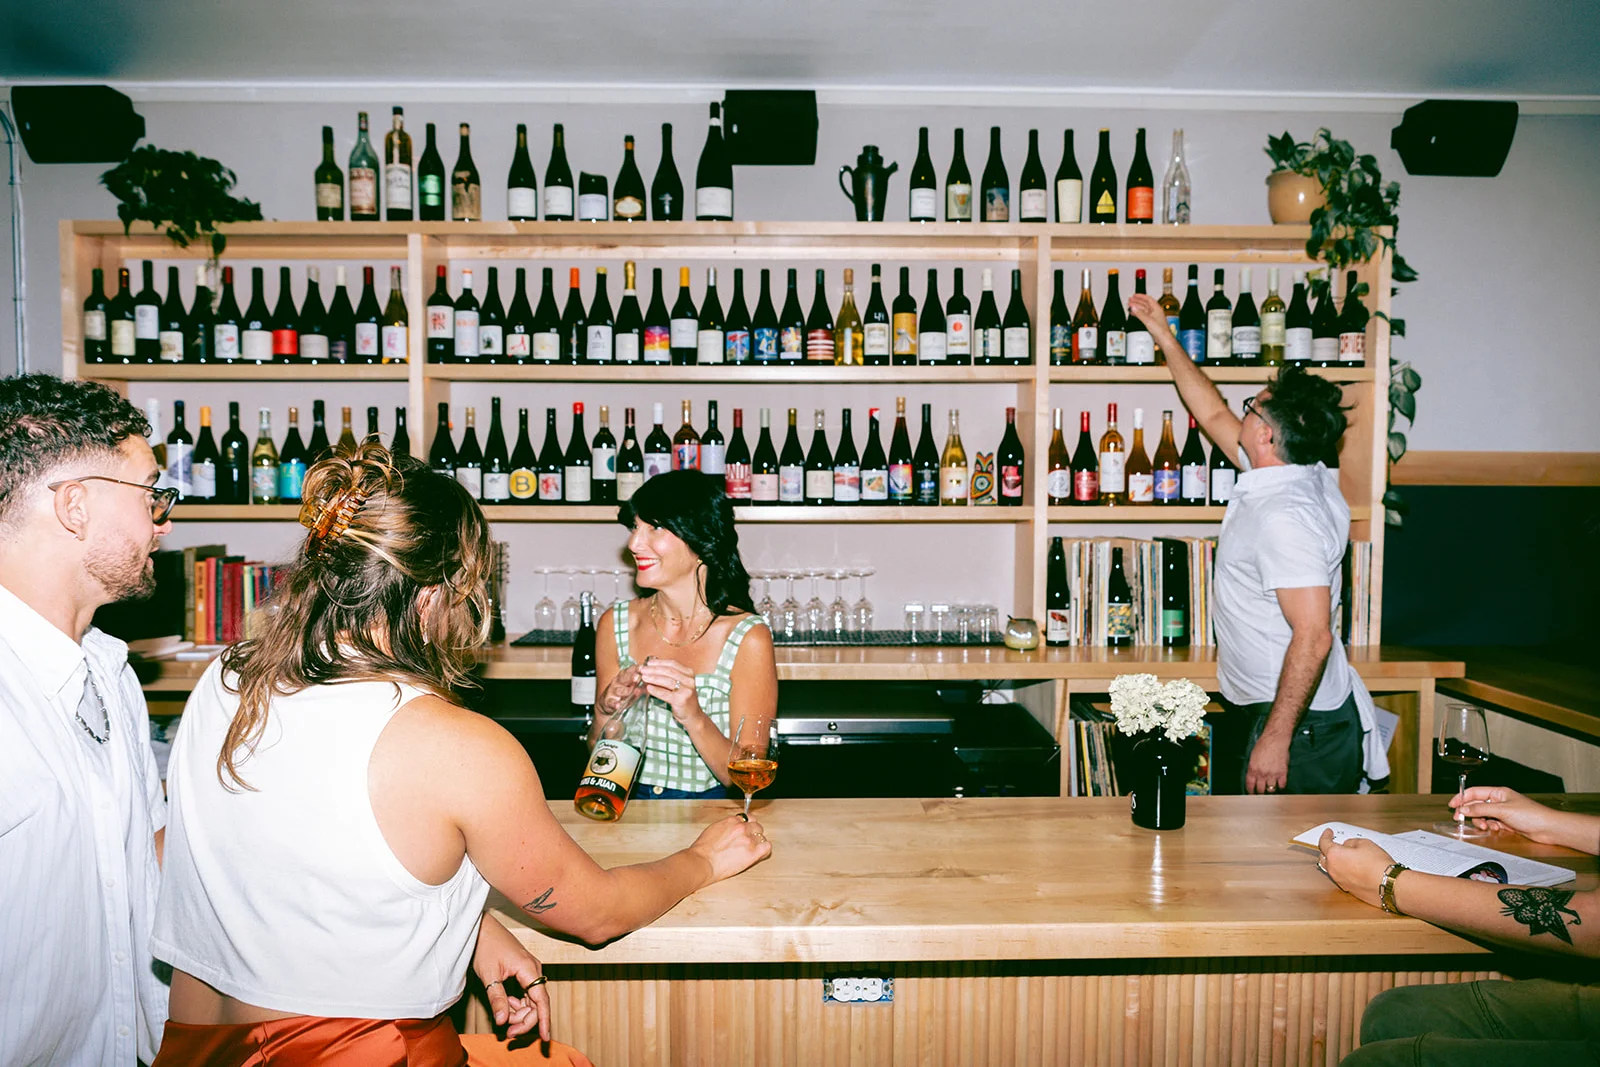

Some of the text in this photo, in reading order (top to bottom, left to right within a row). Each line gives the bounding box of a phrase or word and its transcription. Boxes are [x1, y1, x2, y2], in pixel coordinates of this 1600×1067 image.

[516, 476, 530, 492] B
[590, 777, 596, 785] &
[596, 778, 616, 791] JUAN
